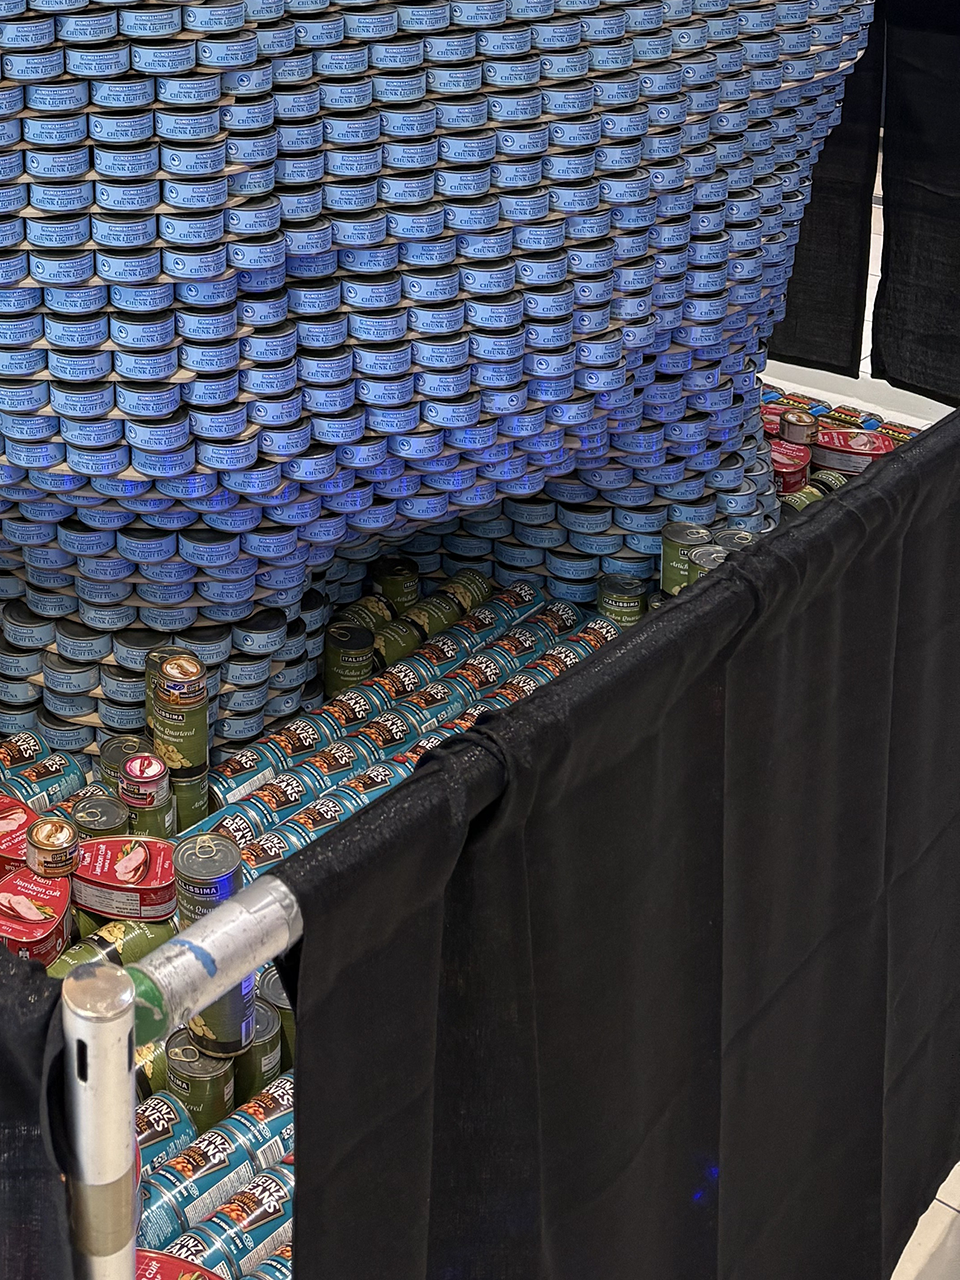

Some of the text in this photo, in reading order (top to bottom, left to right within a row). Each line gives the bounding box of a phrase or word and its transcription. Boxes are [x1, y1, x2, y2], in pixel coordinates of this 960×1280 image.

[126, 23, 167, 31] CHUNK LIGHT
[54, 131, 73, 139] LIGHT
[166, 127, 205, 135] CHUNK LIGHT
[473, 246, 495, 254] CHUNK
[352, 327, 390, 336] CHUNK LIGHT
[58, 404, 96, 412] CHUNK LIGHT
[547, 604, 574, 627] FEVES
[554, 601, 578, 622] HEINZ
[395, 663, 418, 683] HEINZ
[467, 657, 497, 684] BEANS
[475, 654, 500, 677] HEINZ
[345, 691, 369, 711] HEINZ
[294, 720, 318, 740] HEINZ
[381, 712, 406, 732] HEINZ
[18, 731, 40, 754] HEINZ
[276, 774, 303, 794] HEINZ
[13, 878, 61, 898] Jambon cuit
[145, 1097, 175, 1122] HEINZ
[253, 1176, 287, 1200] HEINZ
